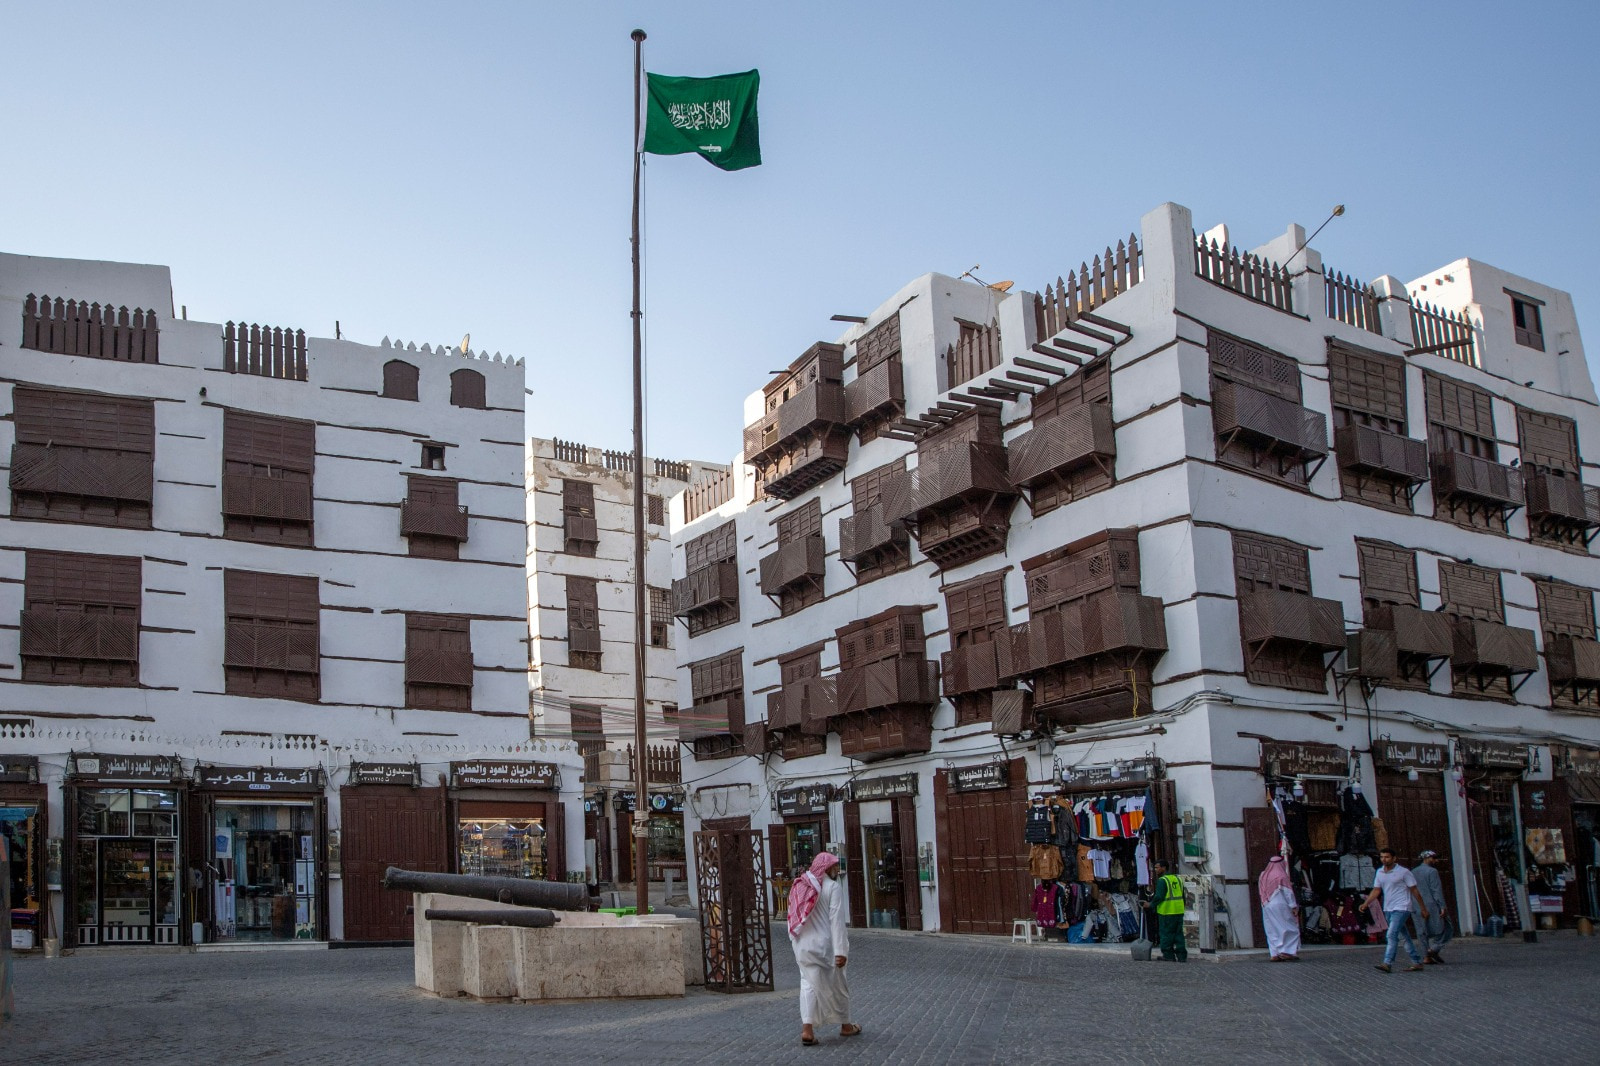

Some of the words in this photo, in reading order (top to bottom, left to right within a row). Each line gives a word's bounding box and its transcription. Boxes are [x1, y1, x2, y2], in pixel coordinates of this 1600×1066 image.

[1419, 747, 1442, 765] البتول
[489, 764, 508, 776] للعود
[510, 764, 536, 777] الريان
[538, 765, 552, 777] ركن
[205, 770, 256, 785] العرب
[263, 770, 313, 785] أقمشة
